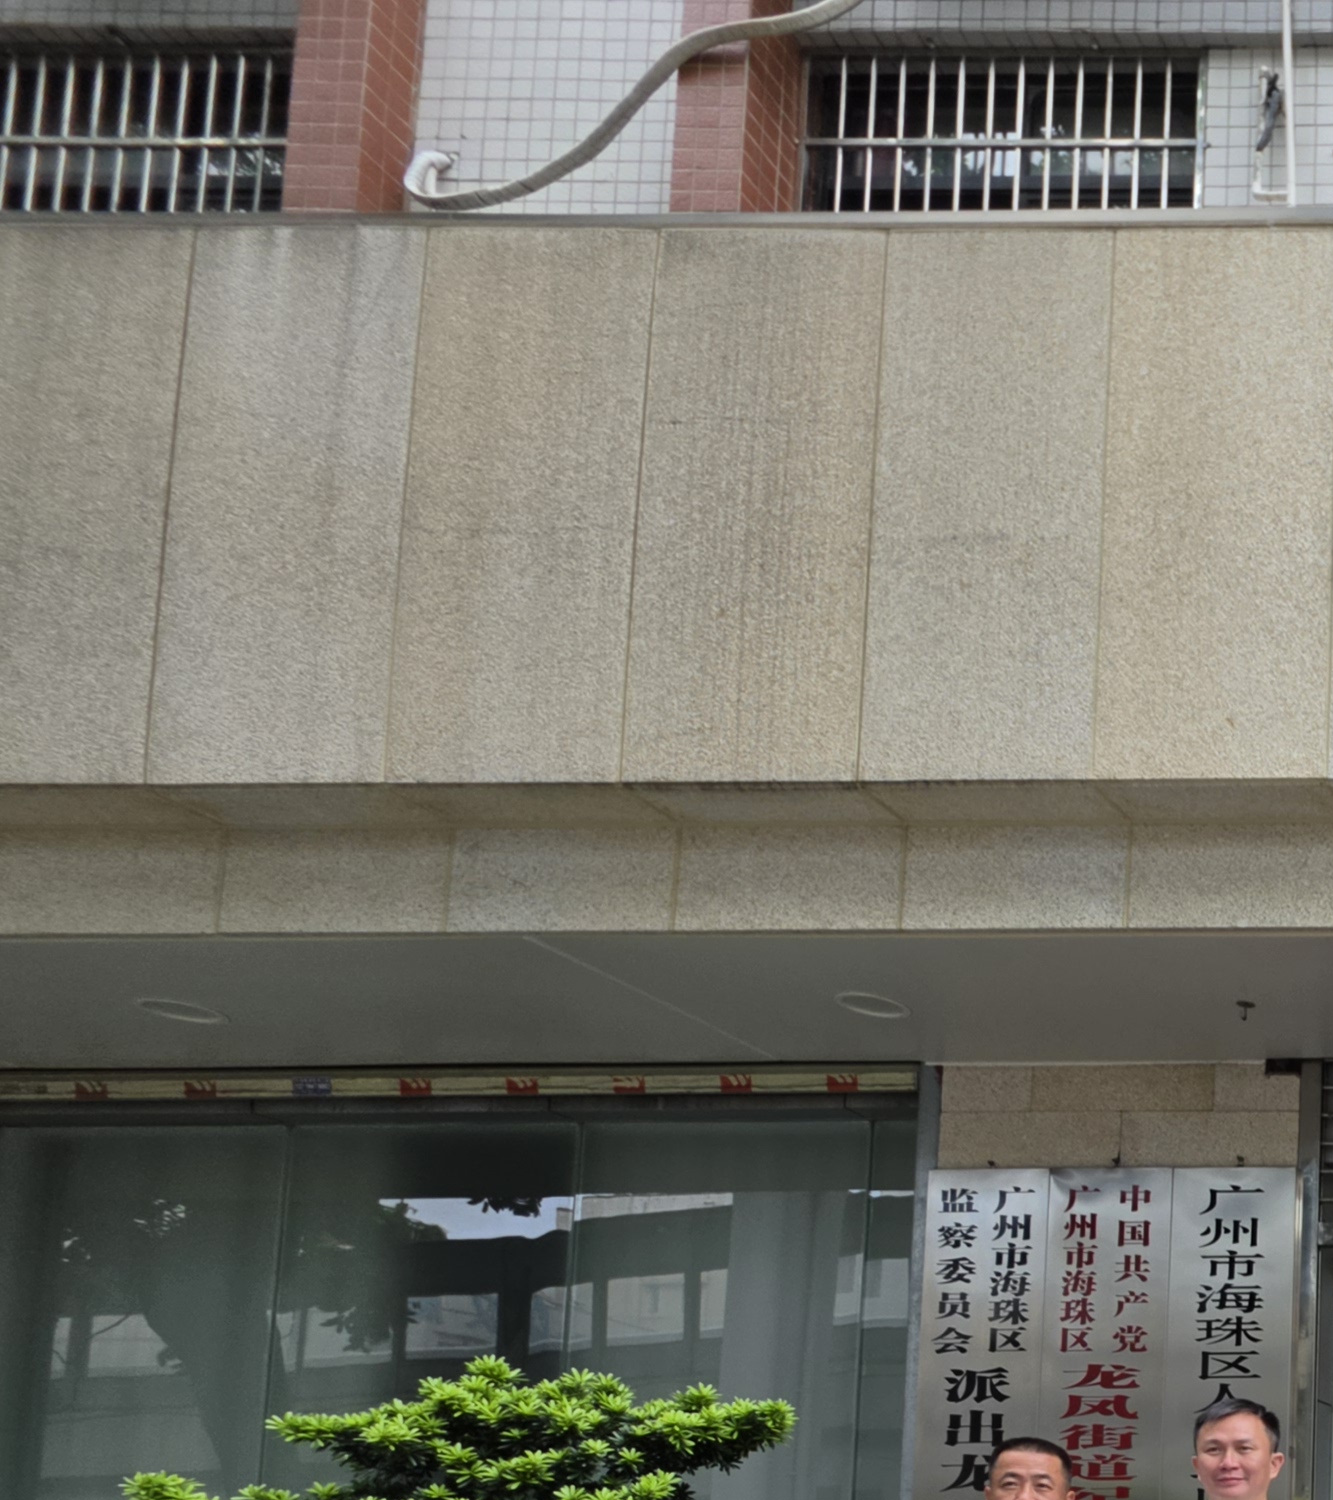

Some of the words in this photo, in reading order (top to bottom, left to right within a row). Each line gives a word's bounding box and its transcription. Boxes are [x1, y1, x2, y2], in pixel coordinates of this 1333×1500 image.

[931, 1187, 980, 1354] 监察委员会
[987, 1185, 1036, 1353] 广州市海珠区
[1059, 1184, 1101, 1353] 广州市海珠区
[1112, 1184, 1152, 1354] 中国共产党
